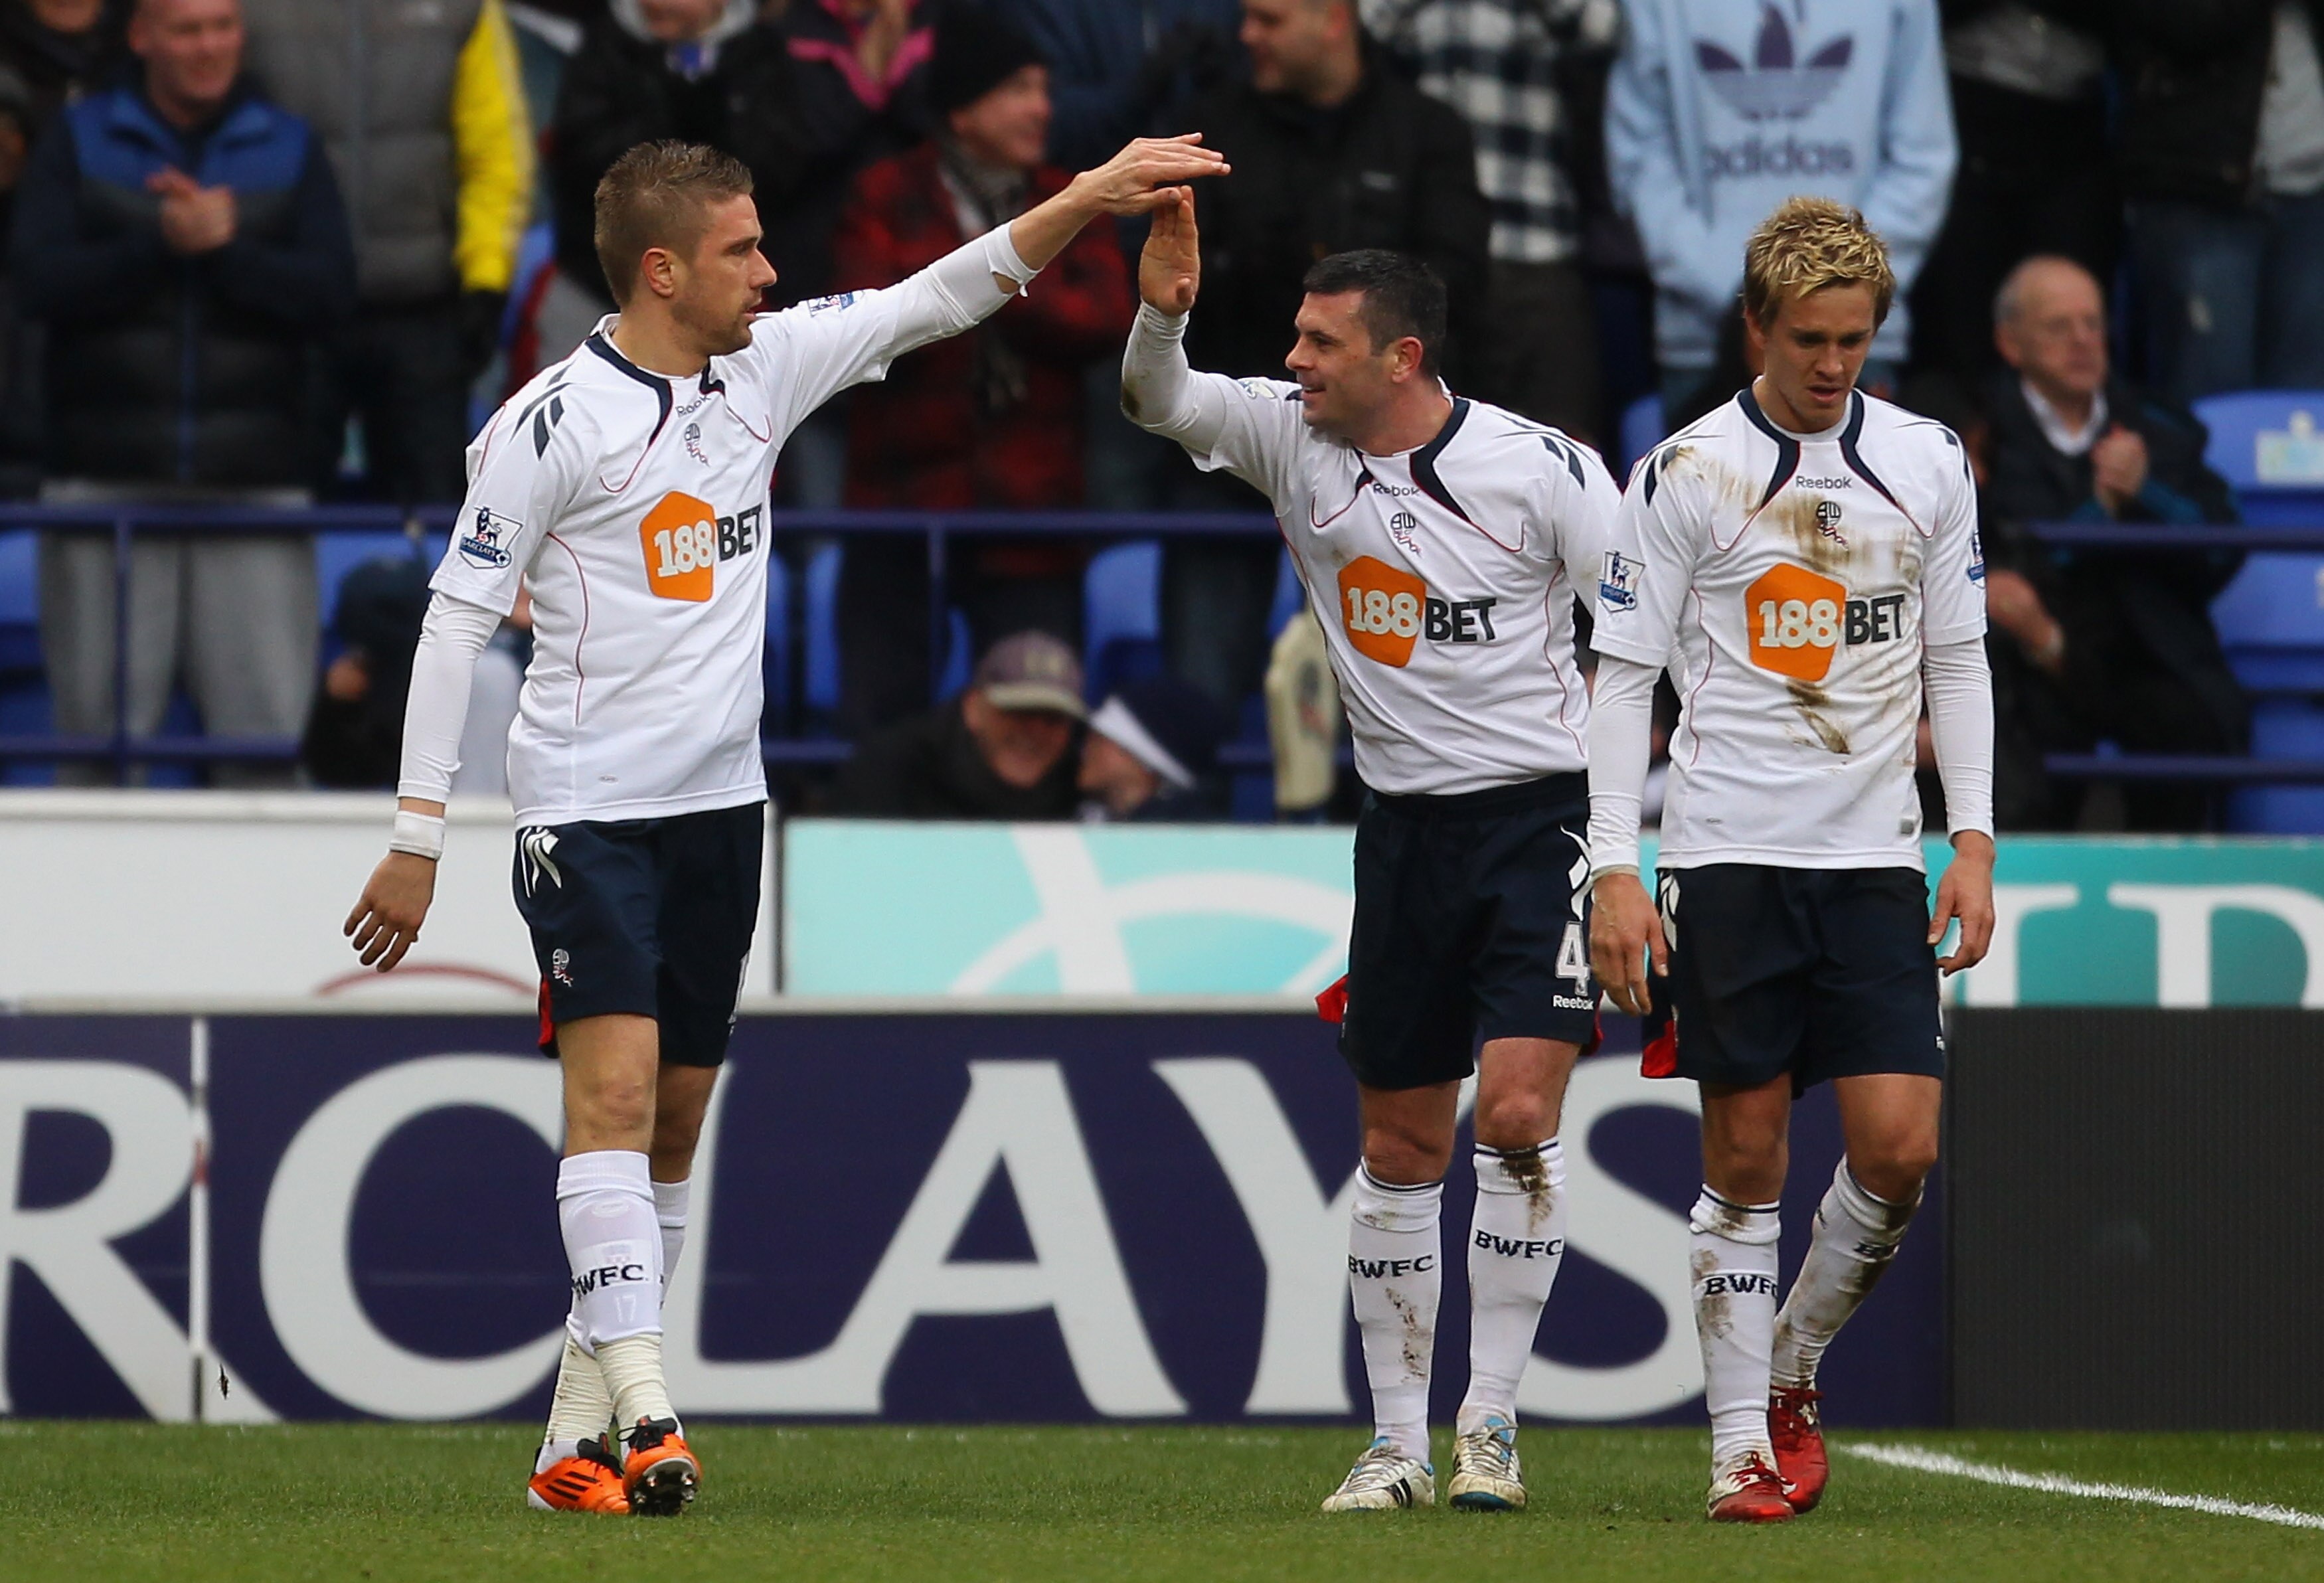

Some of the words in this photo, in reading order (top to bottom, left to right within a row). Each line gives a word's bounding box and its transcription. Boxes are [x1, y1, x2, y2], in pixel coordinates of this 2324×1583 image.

[1701, 137, 1854, 178] adidas
[1796, 475, 1852, 489] Reebok
[654, 503, 762, 578] 188BET
[1347, 587, 1497, 642] 188BET
[1759, 594, 1905, 648] 188BET
[1555, 920, 1590, 996] 4
[1552, 995, 1594, 1011] Reebok
[1475, 1230, 1563, 1259] BWFC
[573, 1264, 643, 1301] WFC
[1348, 1253, 1434, 1278] BWFC
